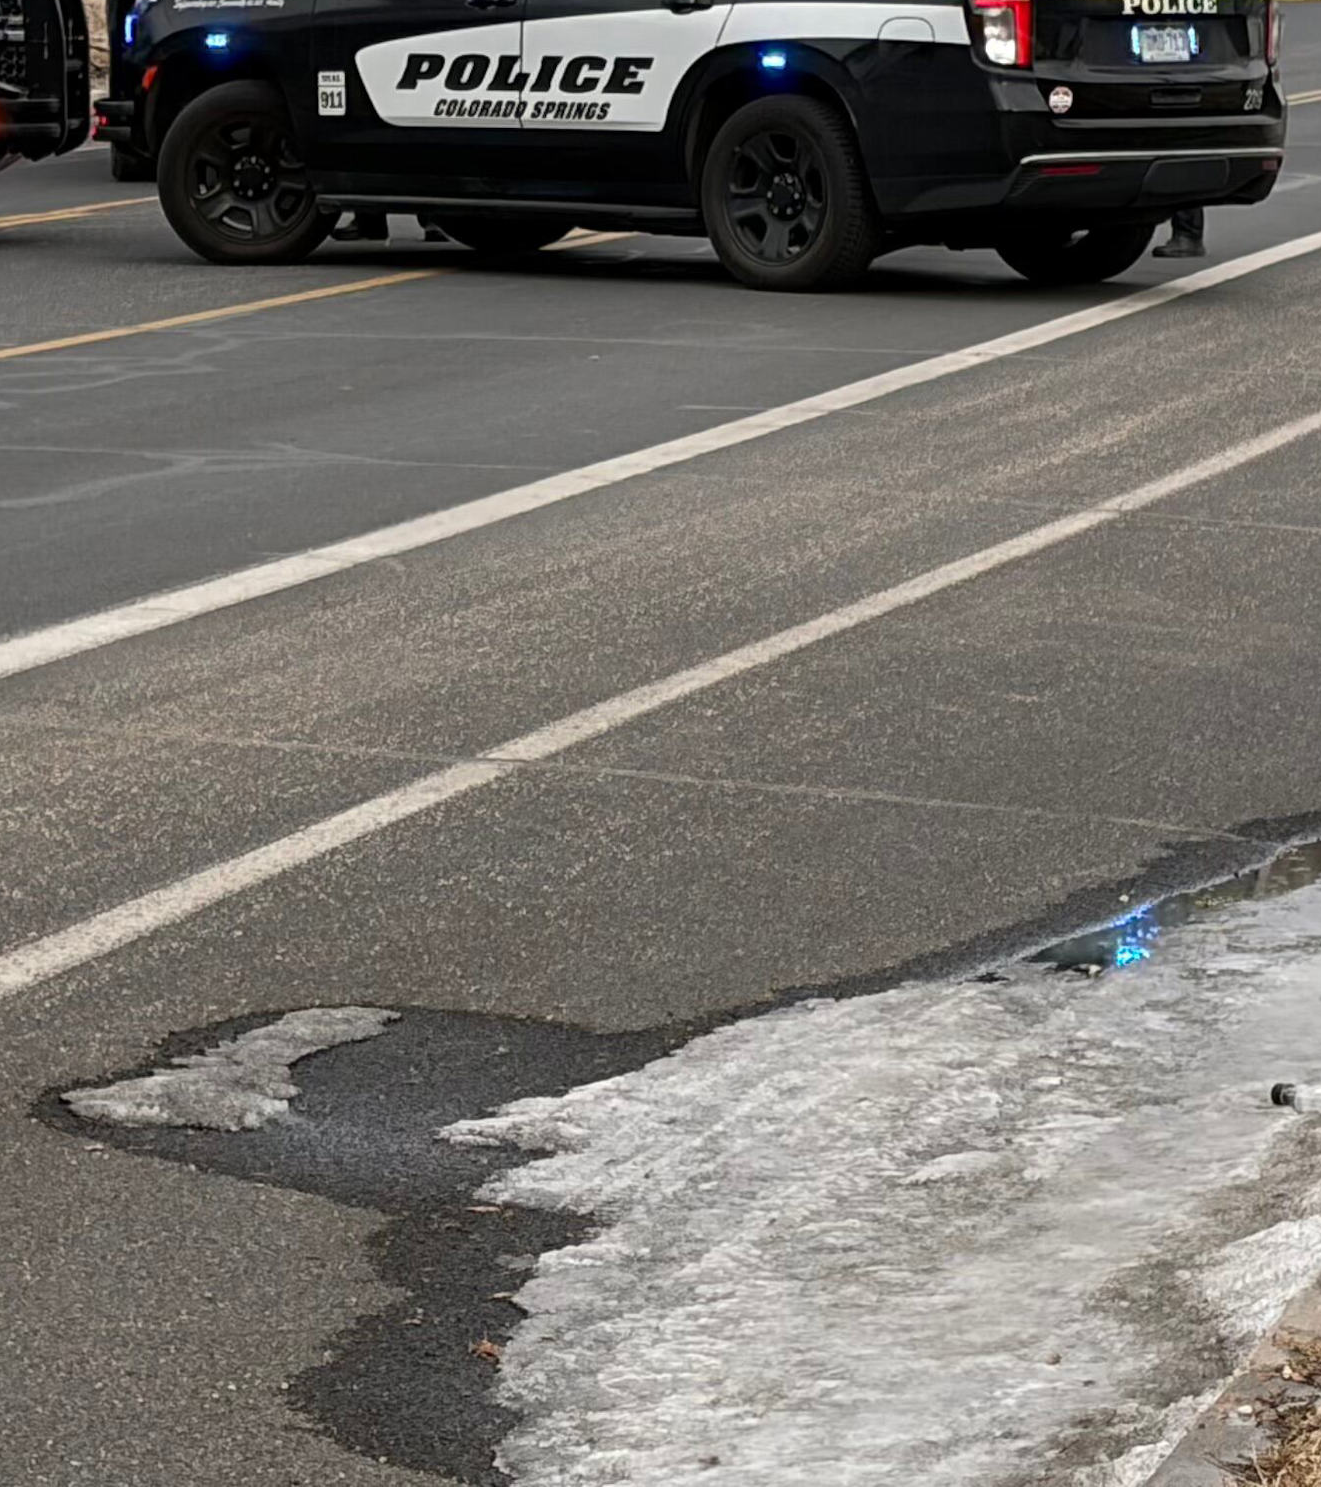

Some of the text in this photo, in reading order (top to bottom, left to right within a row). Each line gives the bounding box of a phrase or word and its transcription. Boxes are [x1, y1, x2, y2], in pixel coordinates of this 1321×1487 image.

[395, 53, 655, 95] POLICE
[320, 91, 343, 109] 911
[433, 98, 611, 121] COLORADO SPRINGS
